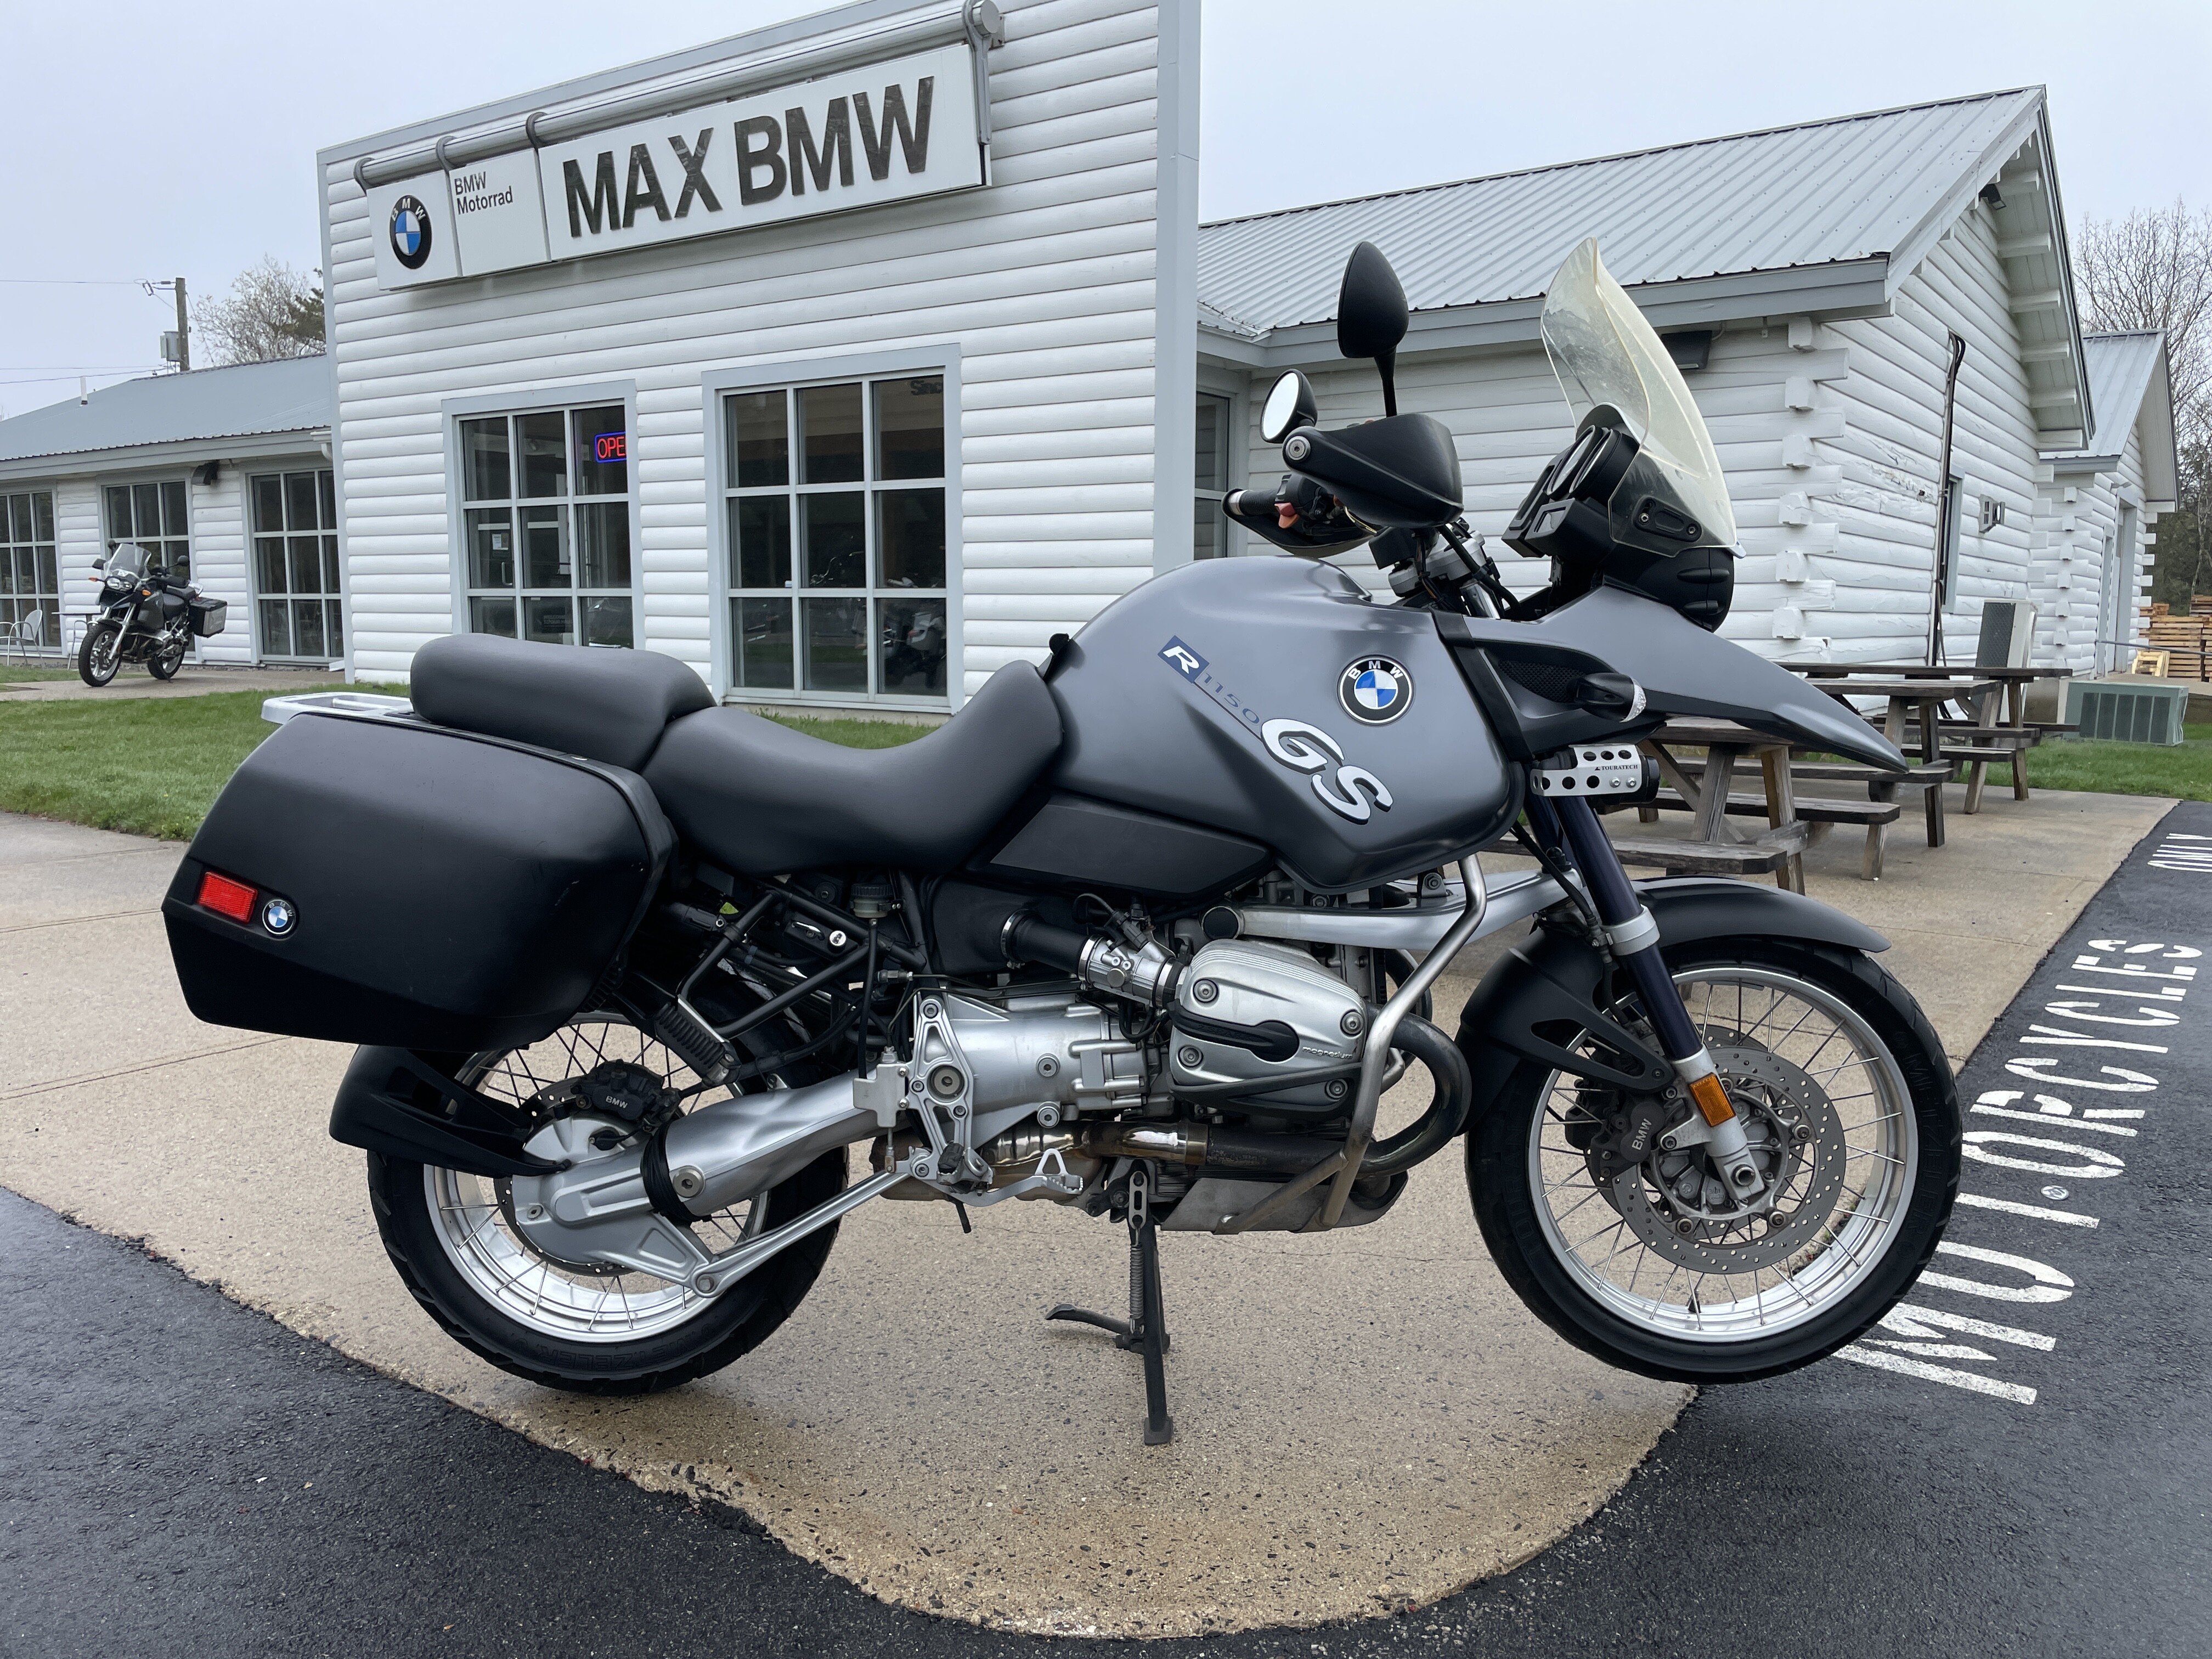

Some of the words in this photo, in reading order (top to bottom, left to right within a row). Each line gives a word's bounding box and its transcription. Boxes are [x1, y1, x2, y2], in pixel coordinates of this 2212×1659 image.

[563, 127, 723, 238] MAX
[734, 76, 934, 206] BMW
[455, 172, 486, 195] BMW
[391, 198, 426, 221] BMW
[456, 185, 513, 215] Motorrad
[597, 436, 626, 459] OPE
[1348, 660, 1403, 680] BMW
[1163, 645, 1199, 674] R
[1204, 672, 1261, 725] 1150
[1261, 718, 1393, 825] GS
[269, 901, 293, 917] BMW
[1302, 1046, 1353, 1059] magnesium
[606, 1096, 628, 1109] BMW
[1632, 1118, 1652, 1150] BMW
